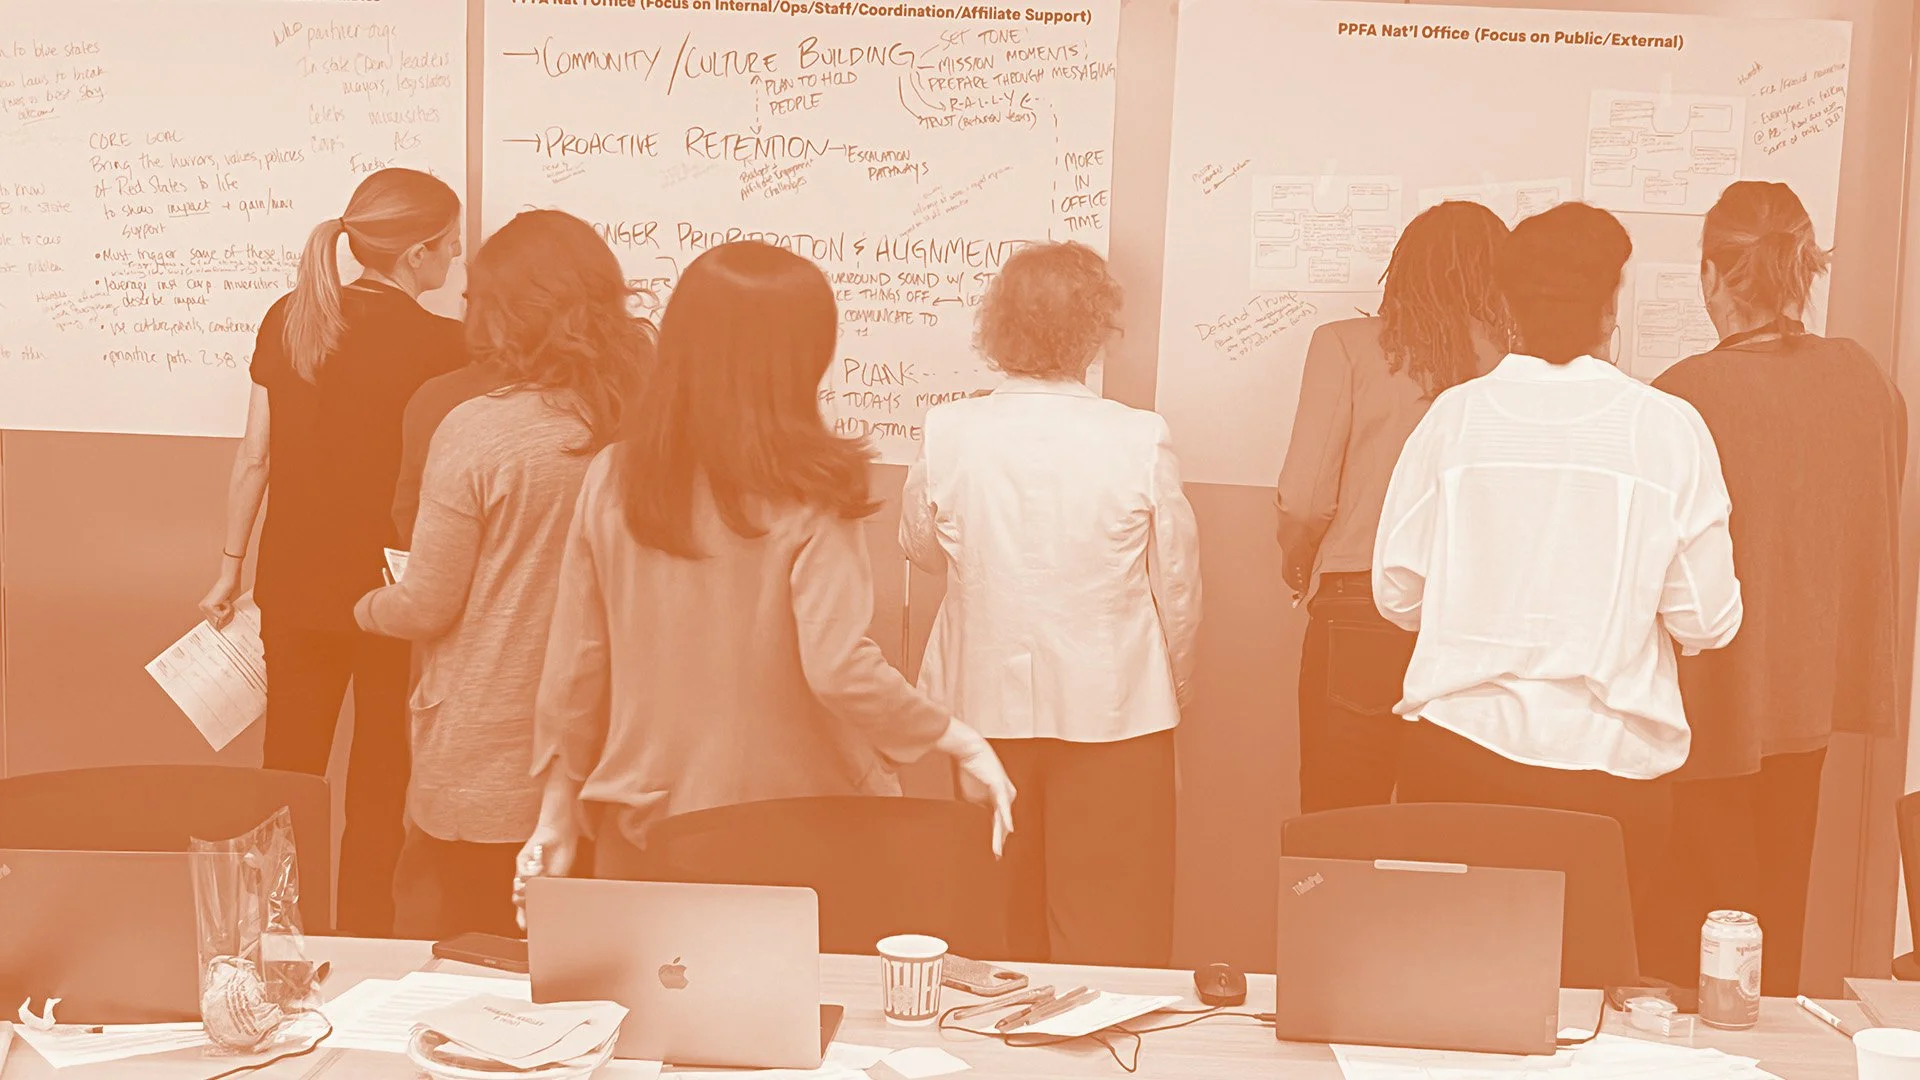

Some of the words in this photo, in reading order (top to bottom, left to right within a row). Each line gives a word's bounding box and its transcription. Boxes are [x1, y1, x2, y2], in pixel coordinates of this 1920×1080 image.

[693, 1, 711, 10] on
[1025, 8, 1092, 25] Support)
[34, 38, 58, 58] blue
[64, 41, 101, 58] states
[940, 29, 971, 51] SET
[978, 28, 1021, 47] TONE
[1339, 23, 1376, 36] PPFA
[1382, 25, 1418, 38] Nat'l
[1422, 26, 1470, 40] Office
[1475, 28, 1526, 43] (Focus
[1531, 32, 1550, 43] on
[1555, 31, 1684, 50] Public/External)
[399, 50, 451, 71] leaders
[543, 36, 661, 81] COMMUNITY
[799, 36, 914, 70] BUILDING
[939, 55, 995, 76] MISSION
[1006, 45, 1079, 63] MOMENTS
[765, 79, 795, 96] PLAN
[797, 74, 818, 88] TO
[821, 72, 858, 89] HOLD
[928, 76, 989, 93] PREPARE
[993, 68, 1045, 87] THROUGH
[1051, 61, 1117, 80] MESSAGING
[769, 92, 822, 116] PEOPLE
[922, 115, 957, 131] TRUST
[89, 132, 131, 150] CORE
[545, 126, 661, 159] PROACTIVE
[685, 126, 829, 161] RETENTION
[90, 154, 133, 180] Bring
[138, 151, 164, 170] the
[848, 145, 911, 164] ESCALATION
[1064, 149, 1106, 172] MORE
[115, 175, 146, 197] Red
[148, 174, 188, 195] States
[215, 172, 240, 192] life
[1074, 174, 1091, 190] IN
[120, 202, 155, 217] show
[1061, 189, 1109, 213] OFFICE
[1063, 213, 1104, 232] TIME
[102, 248, 132, 262] Must
[244, 242, 276, 262] these
[280, 244, 301, 262] law
[877, 235, 1036, 269] ALIGNMENT
[898, 271, 940, 289] SOUND
[906, 291, 930, 304] OFF
[844, 308, 914, 326] COMMUNICATE
[919, 312, 939, 327] TO
[1194, 307, 1250, 343] Defund
[1247, 290, 1300, 313] Trump
[841, 390, 901, 414] TODAYS
